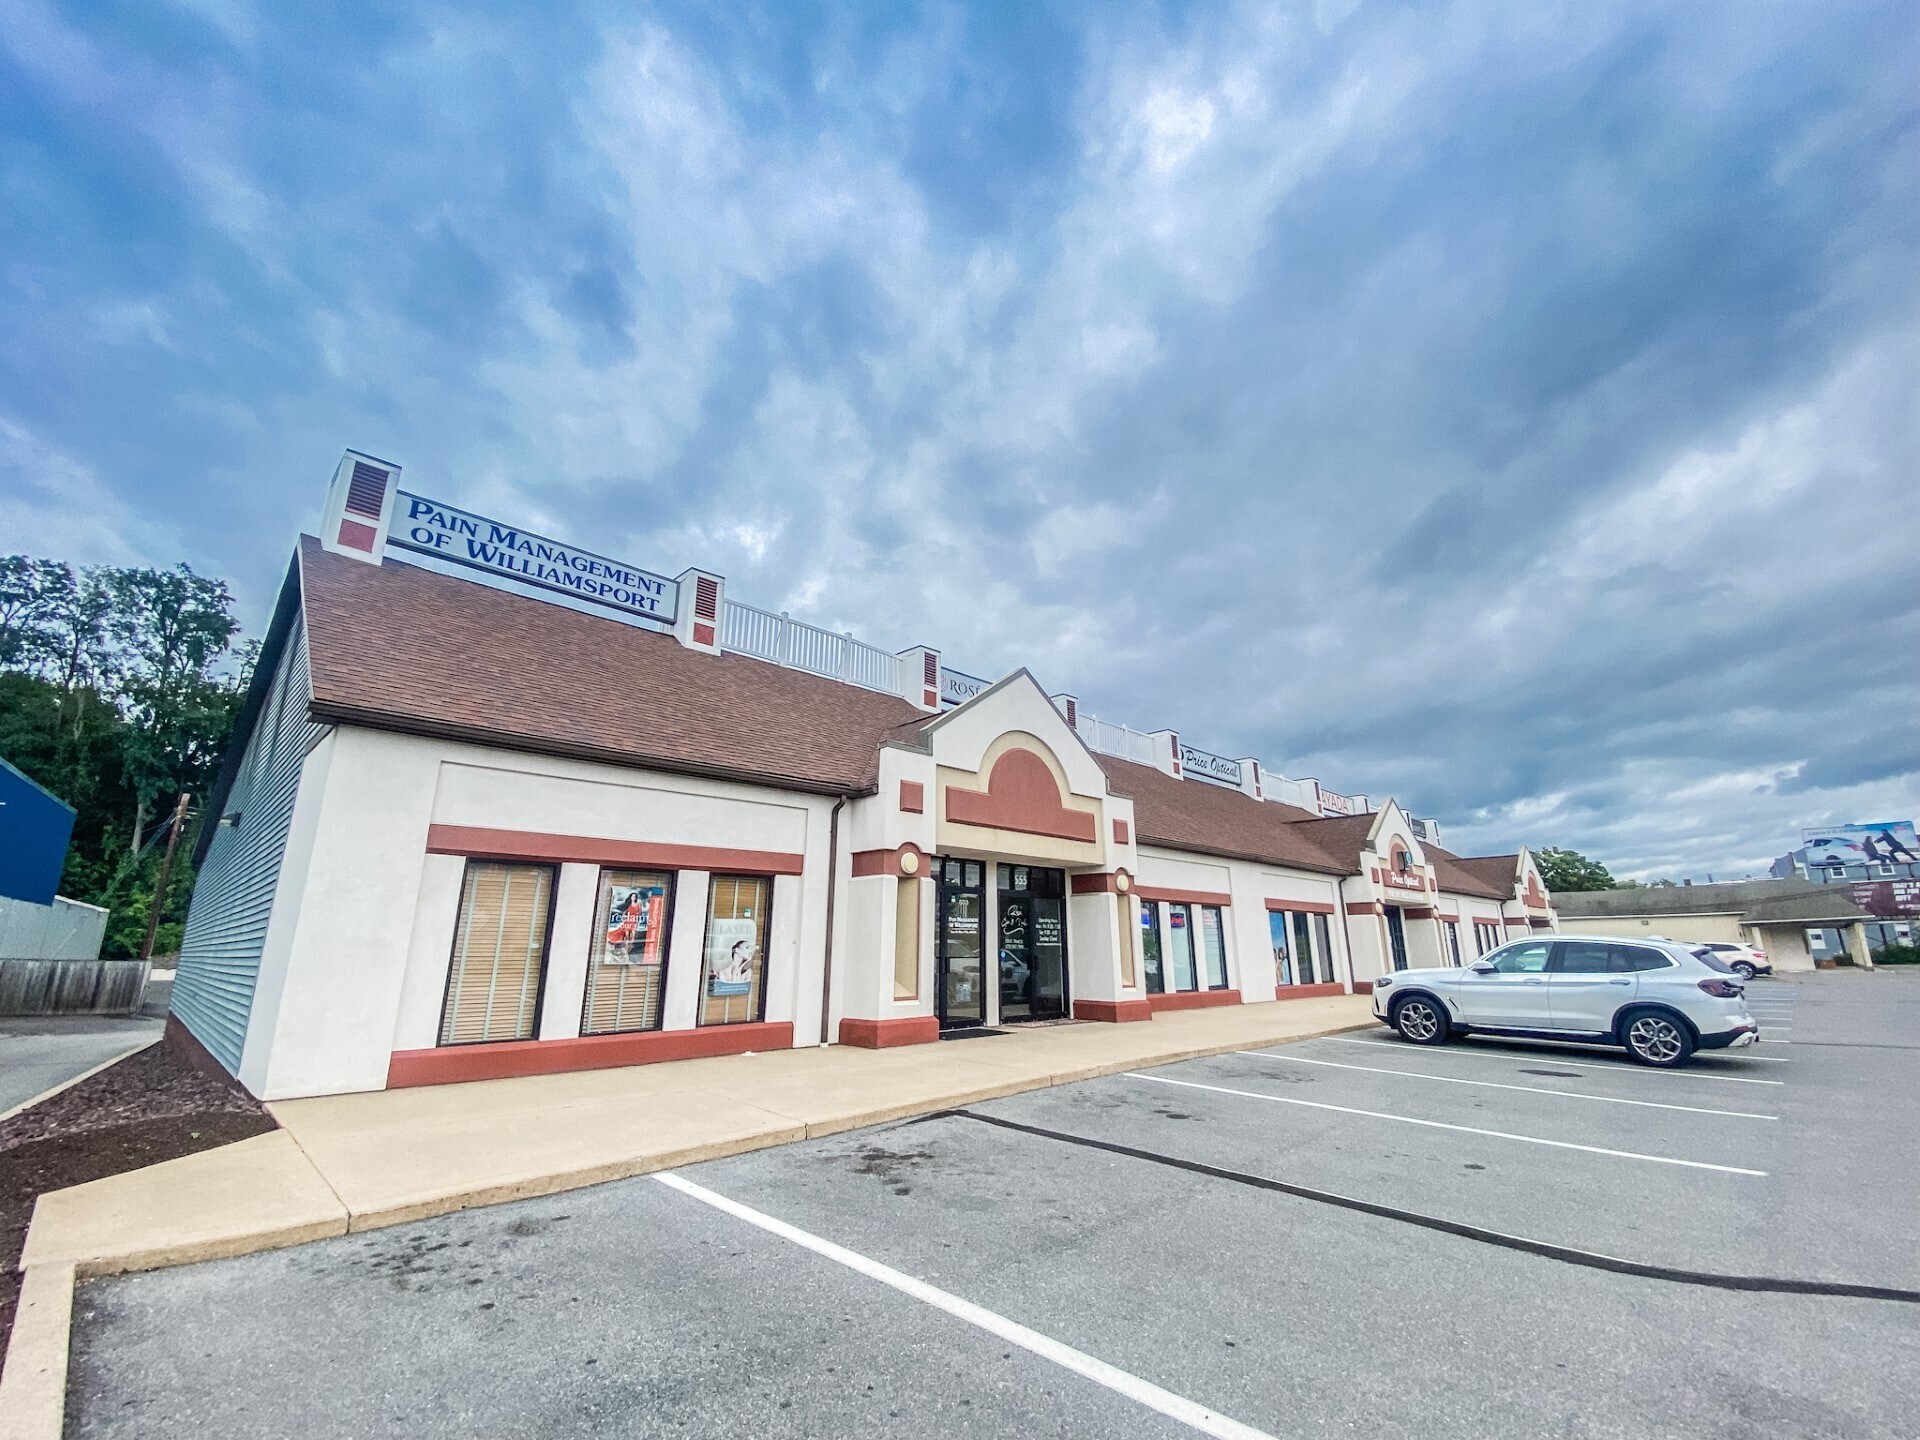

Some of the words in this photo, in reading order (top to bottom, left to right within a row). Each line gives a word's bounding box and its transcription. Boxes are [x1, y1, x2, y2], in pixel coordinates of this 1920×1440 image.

[408, 499, 480, 538] PAIN
[487, 524, 666, 596] MANAGEMENT
[410, 526, 452, 549] OF
[466, 537, 660, 612] WILLIAMSPORT
[1185, 749, 1208, 769] Price
[1210, 757, 1238, 778] Optical
[1014, 874, 1028, 886] 555
[611, 911, 652, 925] reclaim
